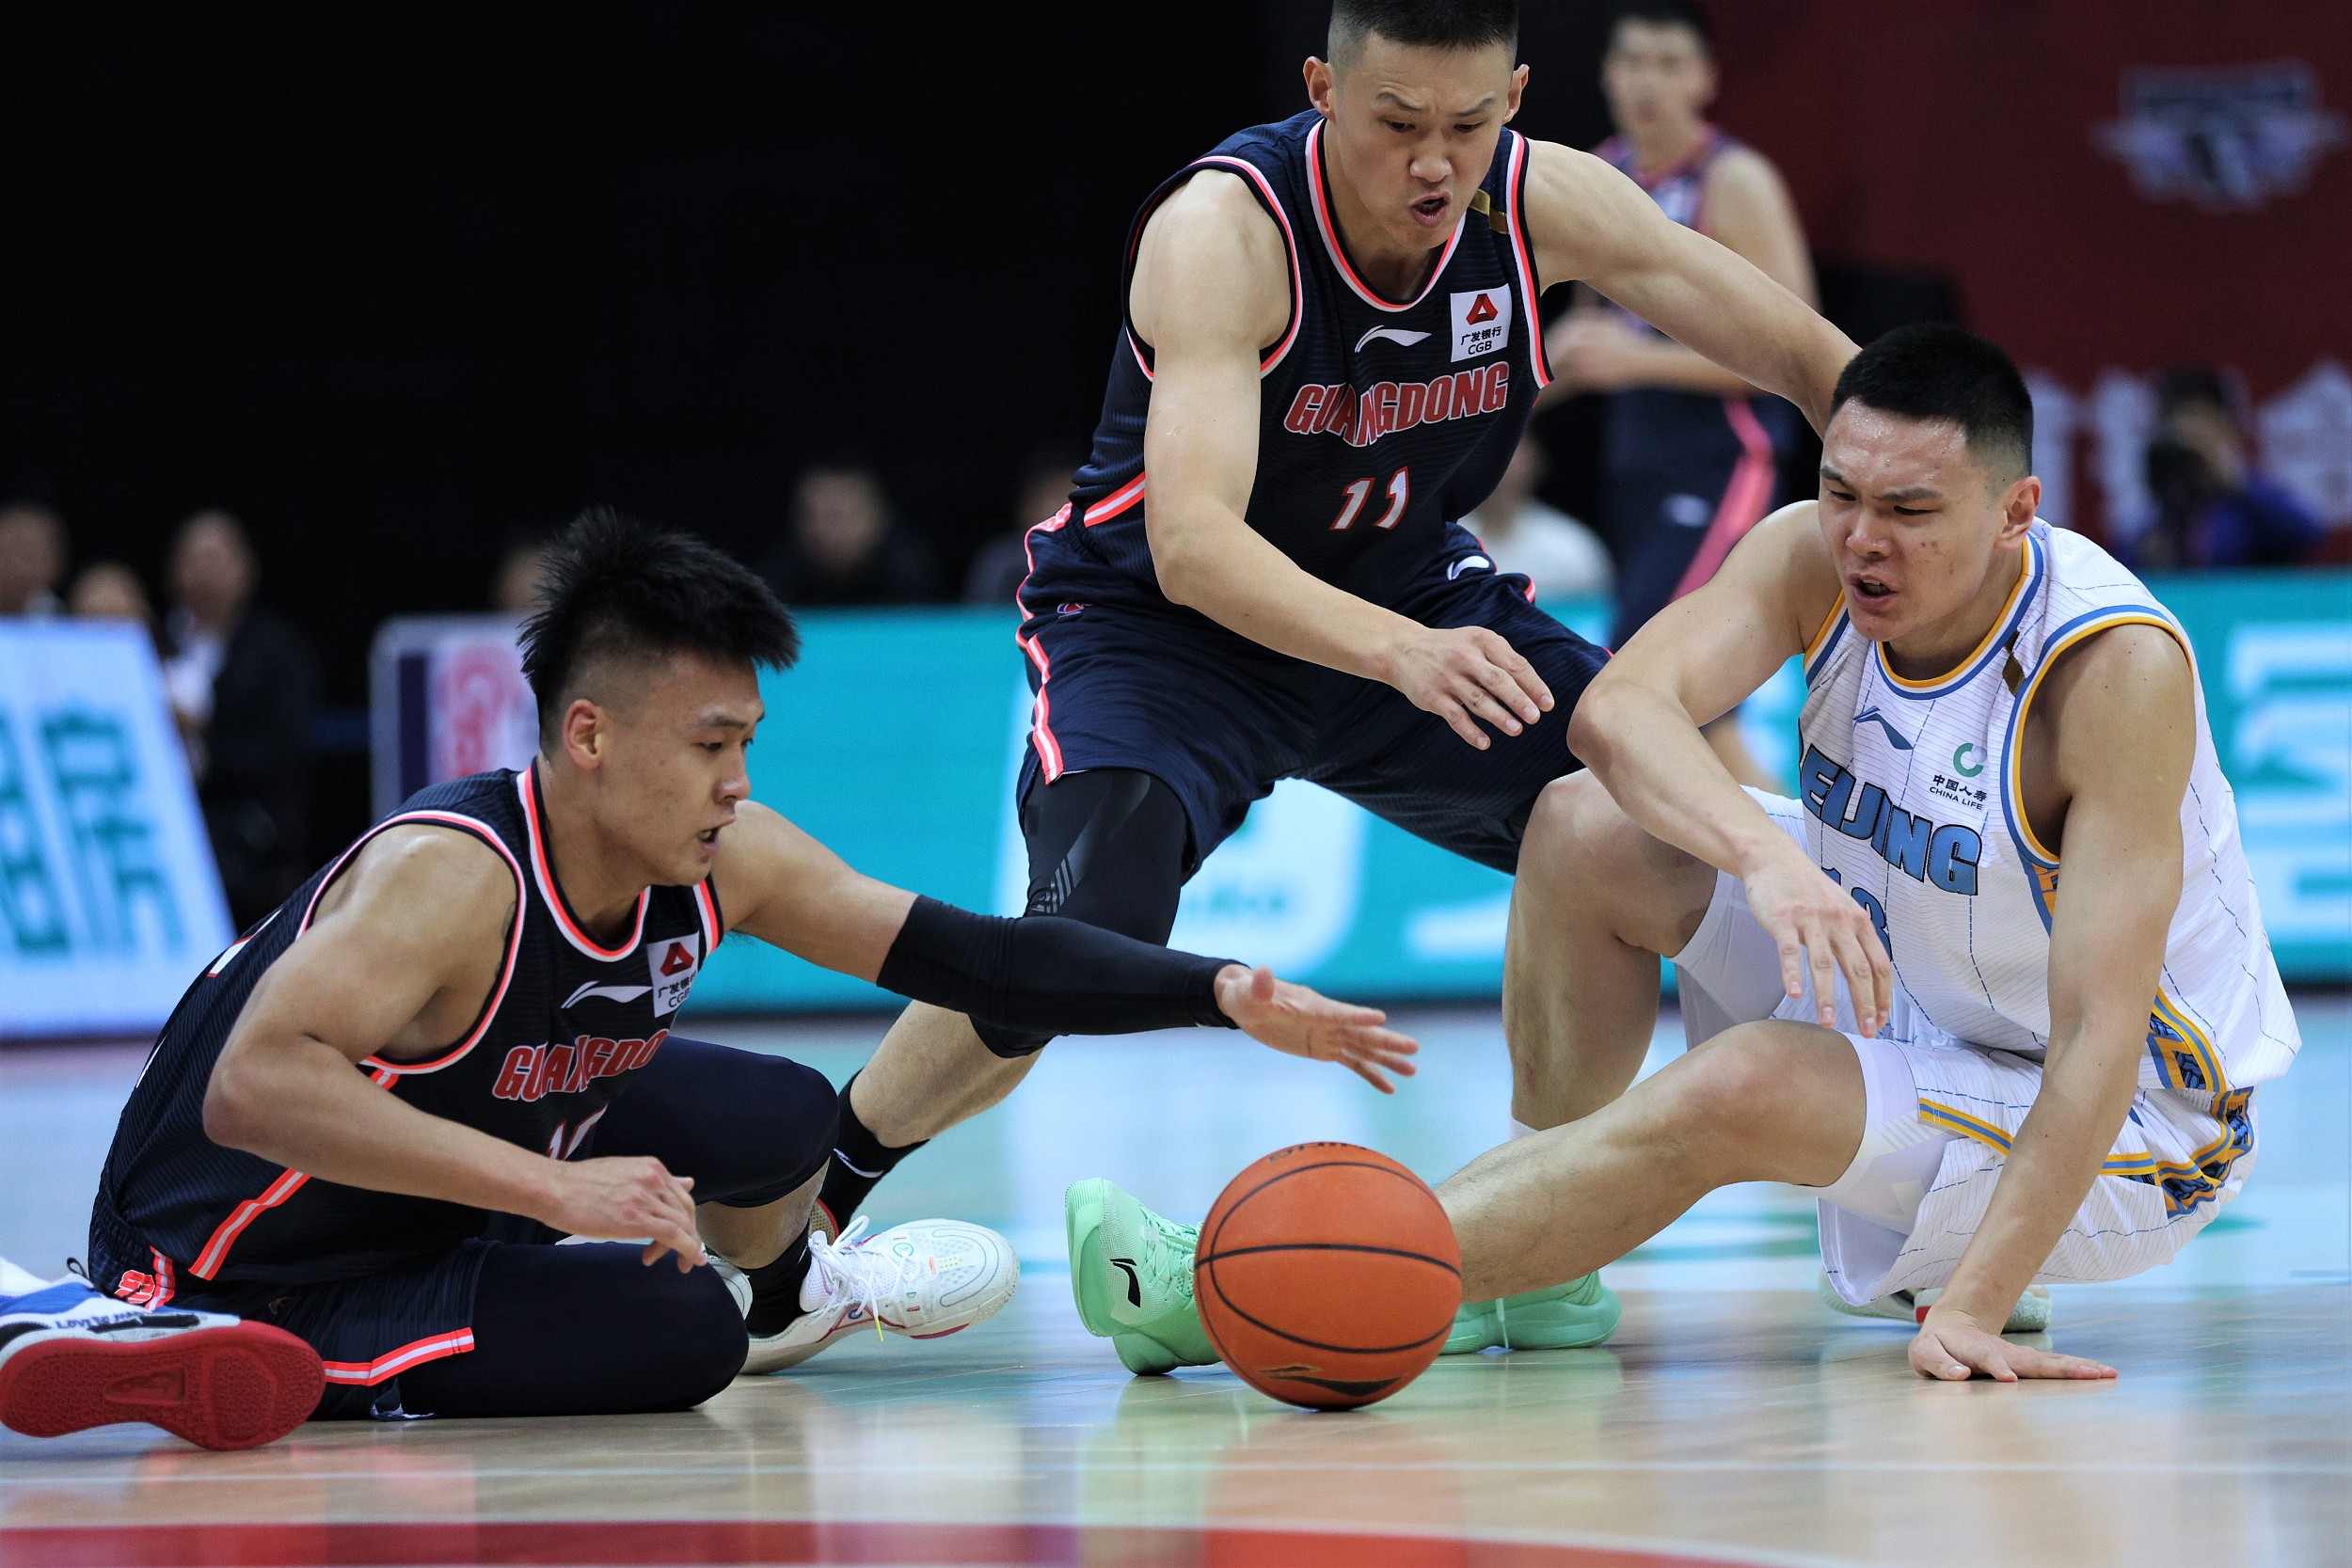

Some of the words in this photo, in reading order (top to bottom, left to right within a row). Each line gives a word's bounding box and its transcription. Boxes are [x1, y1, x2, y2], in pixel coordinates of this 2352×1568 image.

[1460, 325, 1502, 346] 广发银行
[1468, 341, 1493, 356] CGB
[1284, 361, 1509, 447] GUANGDONG
[1328, 467, 1409, 531] 11
[1929, 786, 1960, 802] CHINA
[1962, 798, 1984, 811] LIFE
[1932, 774, 1988, 802] 中国人寿
[1798, 734, 1983, 896] EIJING
